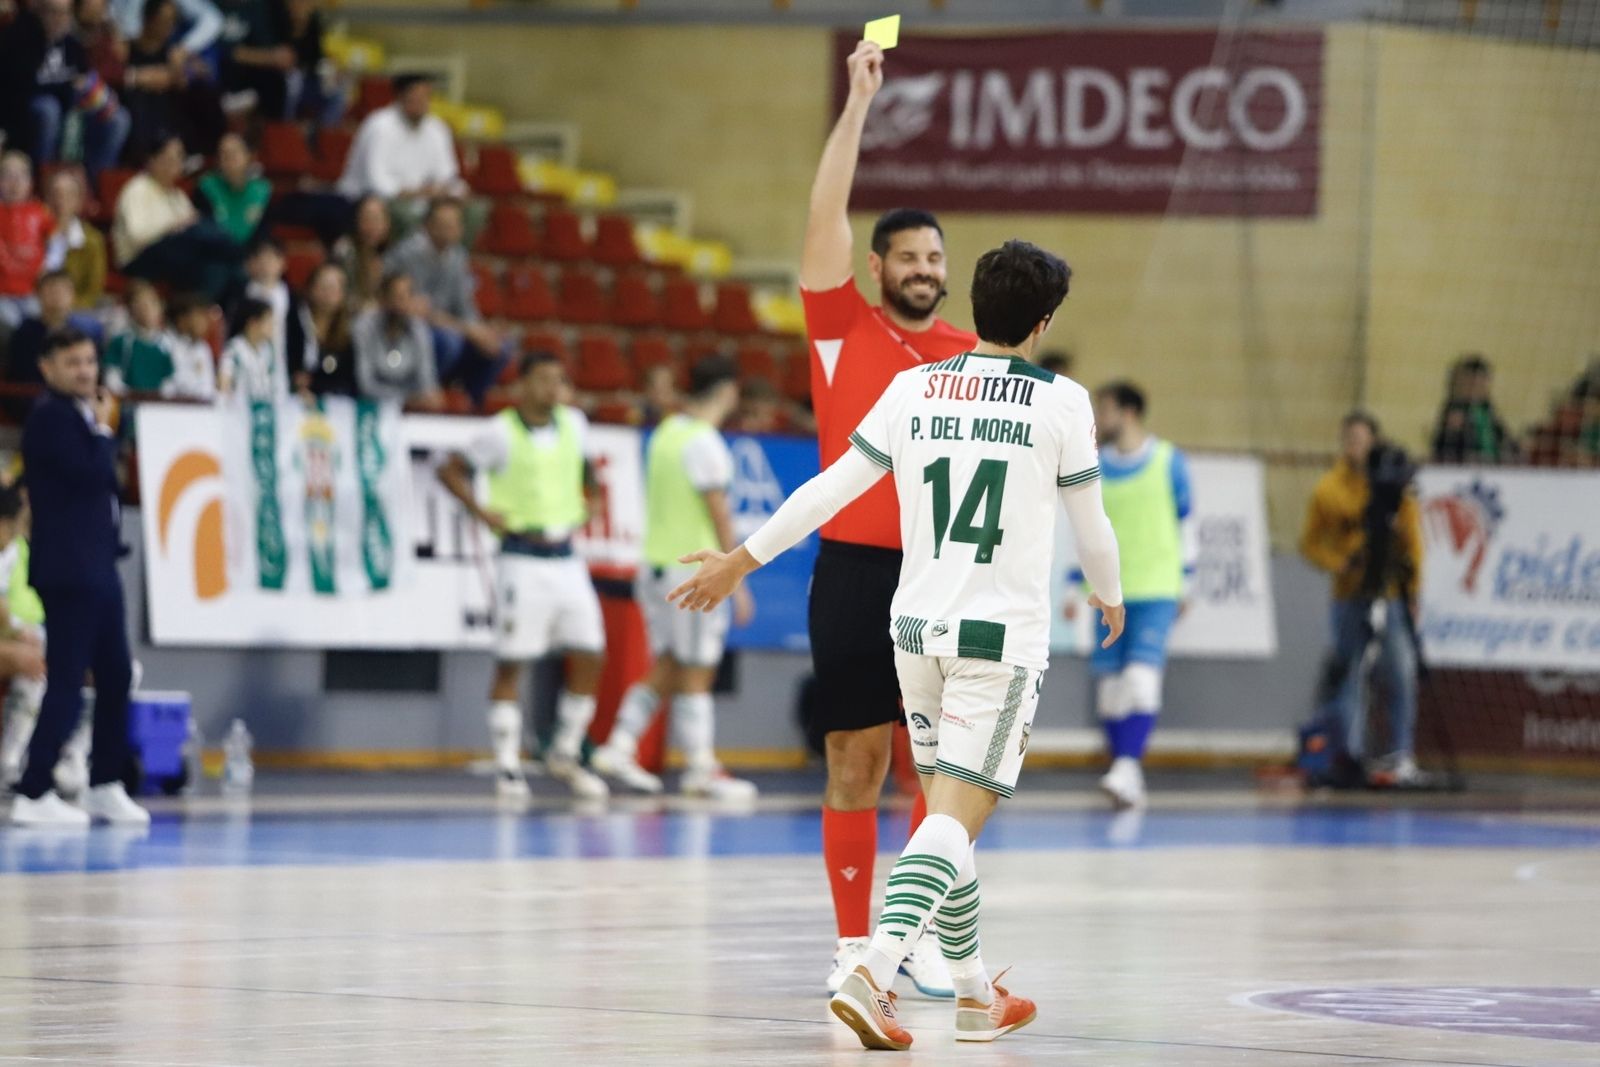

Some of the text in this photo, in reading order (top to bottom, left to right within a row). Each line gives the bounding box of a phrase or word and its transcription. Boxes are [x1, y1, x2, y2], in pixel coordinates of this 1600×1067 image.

[949, 67, 1307, 150] IMDECO
[911, 416, 1034, 448] P. DEL MORAL
[923, 456, 1009, 564] 14
